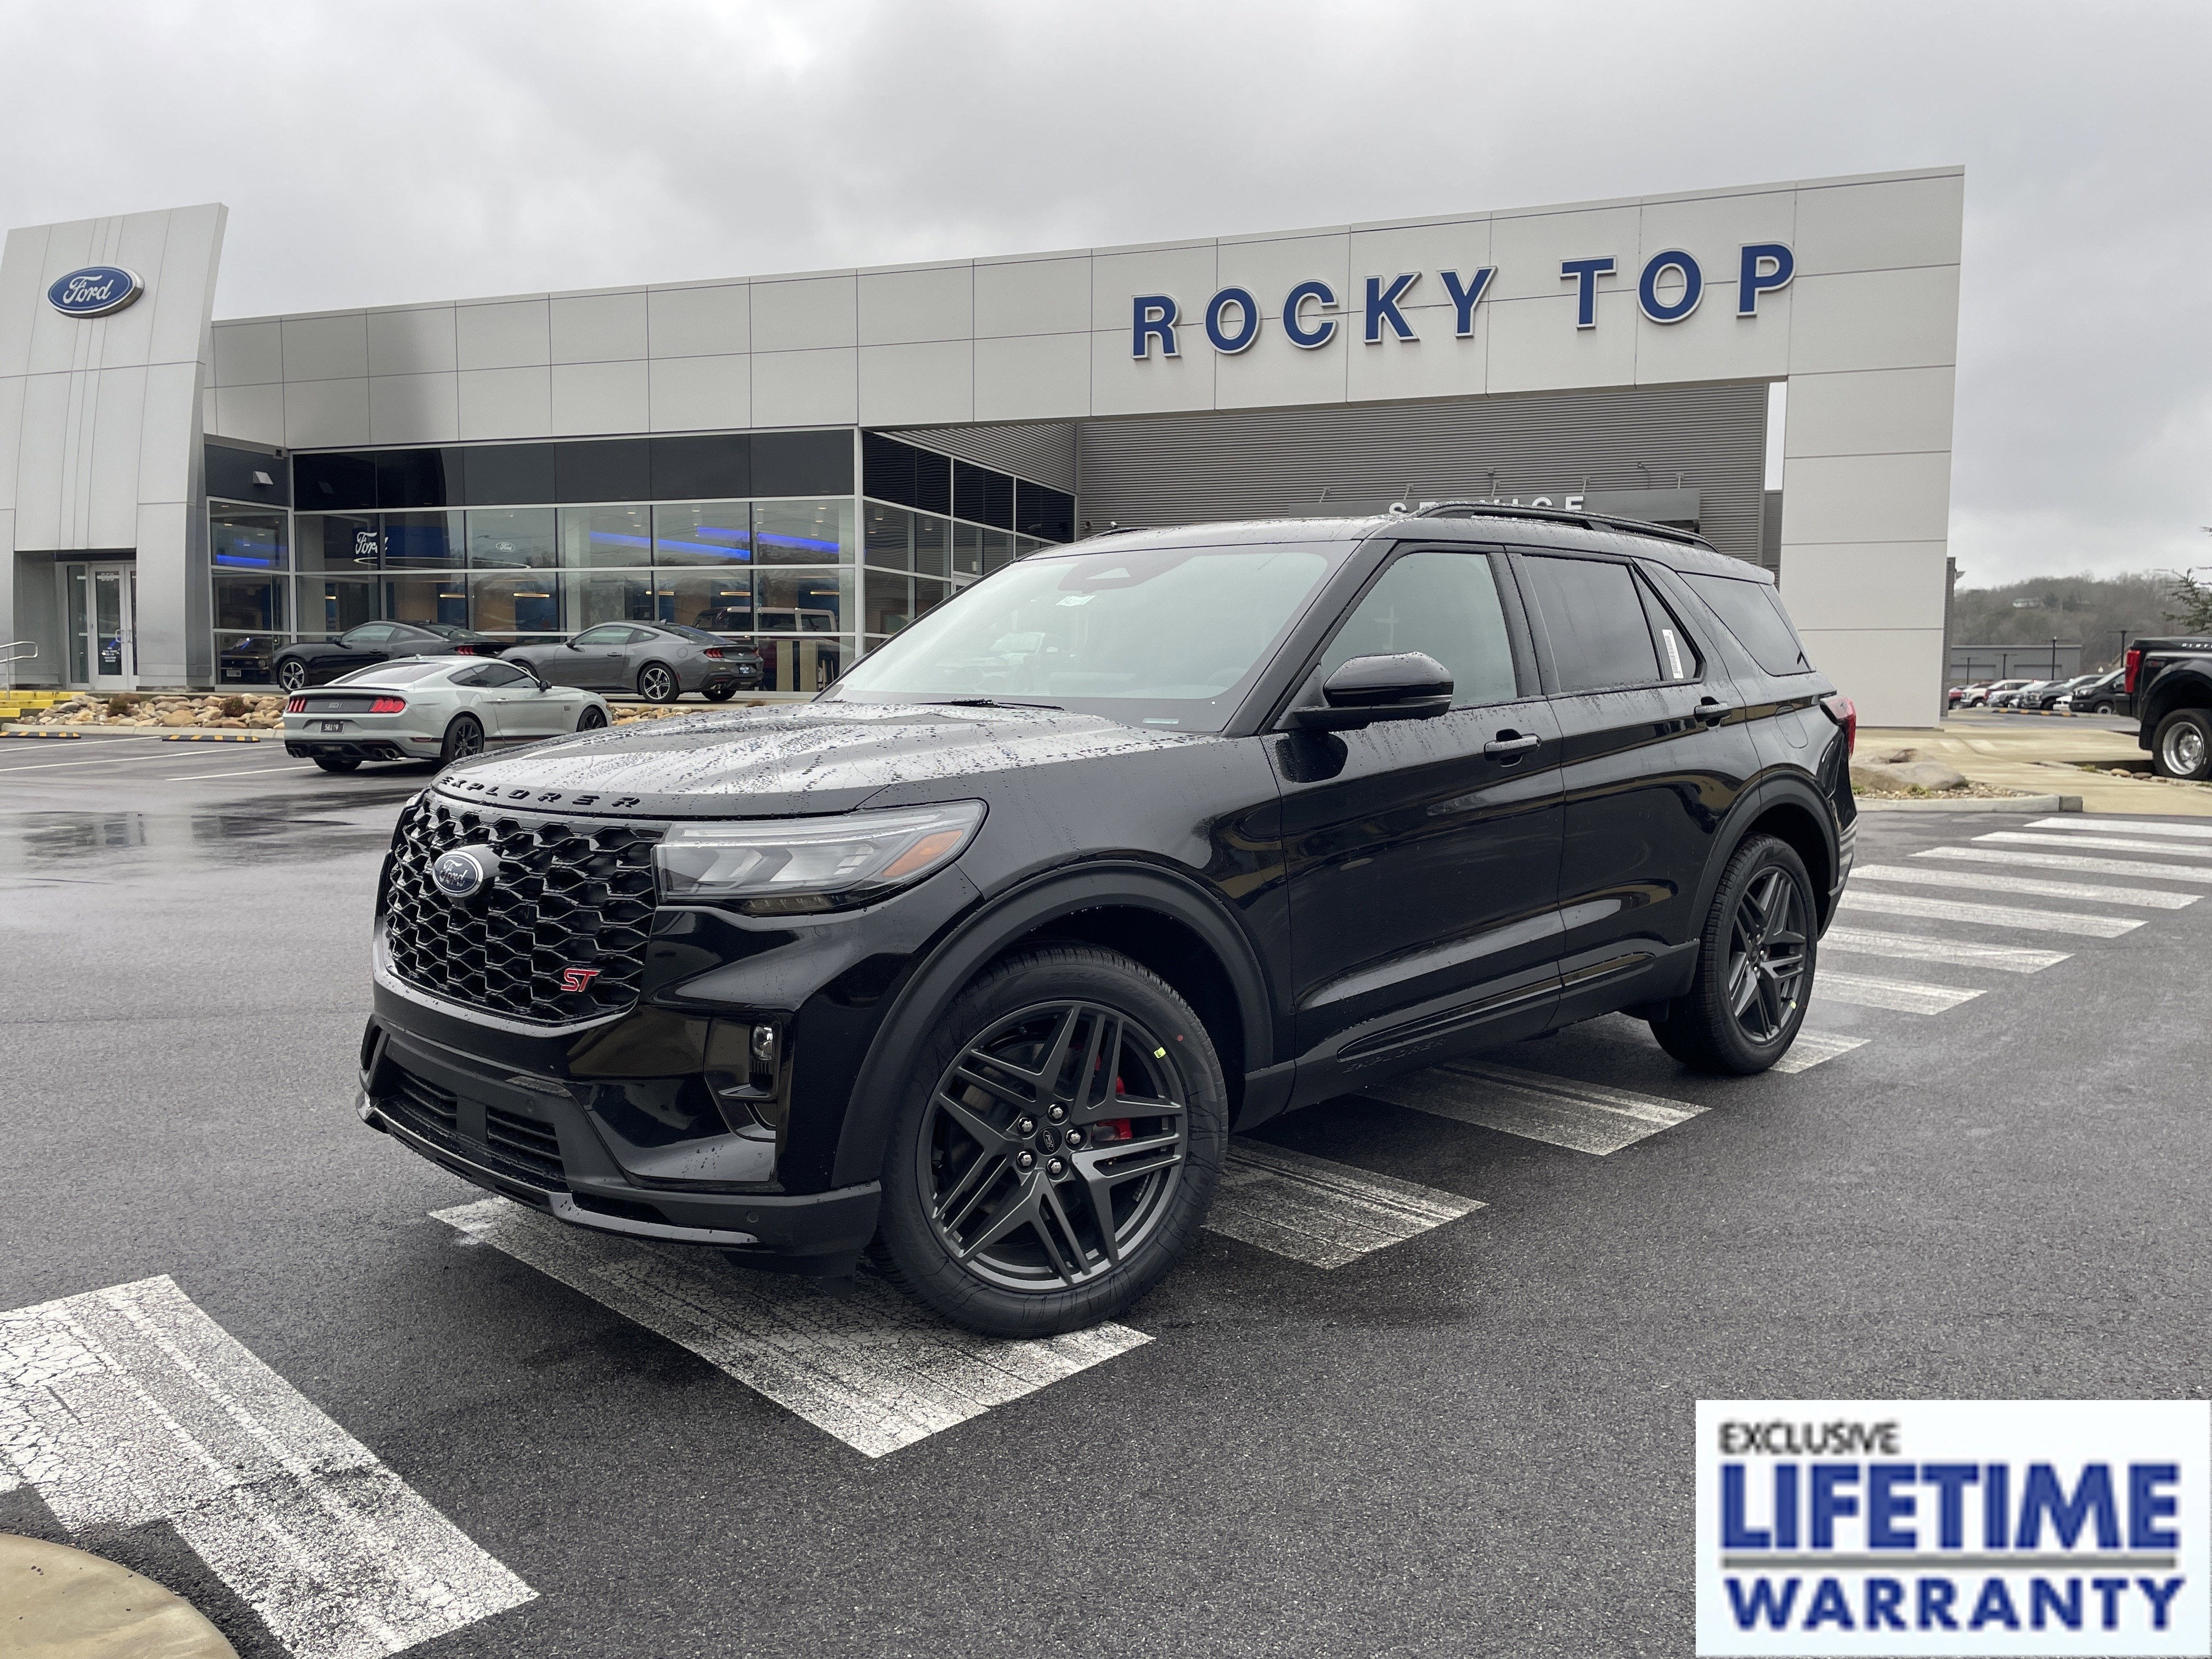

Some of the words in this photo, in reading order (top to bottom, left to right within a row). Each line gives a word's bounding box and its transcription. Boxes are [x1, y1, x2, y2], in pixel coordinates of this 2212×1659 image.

[63, 275, 114, 304] Ford
[1131, 265, 1497, 360] ROCKY
[1559, 241, 1796, 330] TOP
[439, 776, 640, 808] EXPLORER
[439, 859, 468, 887] Ford
[561, 968, 601, 992] ST
